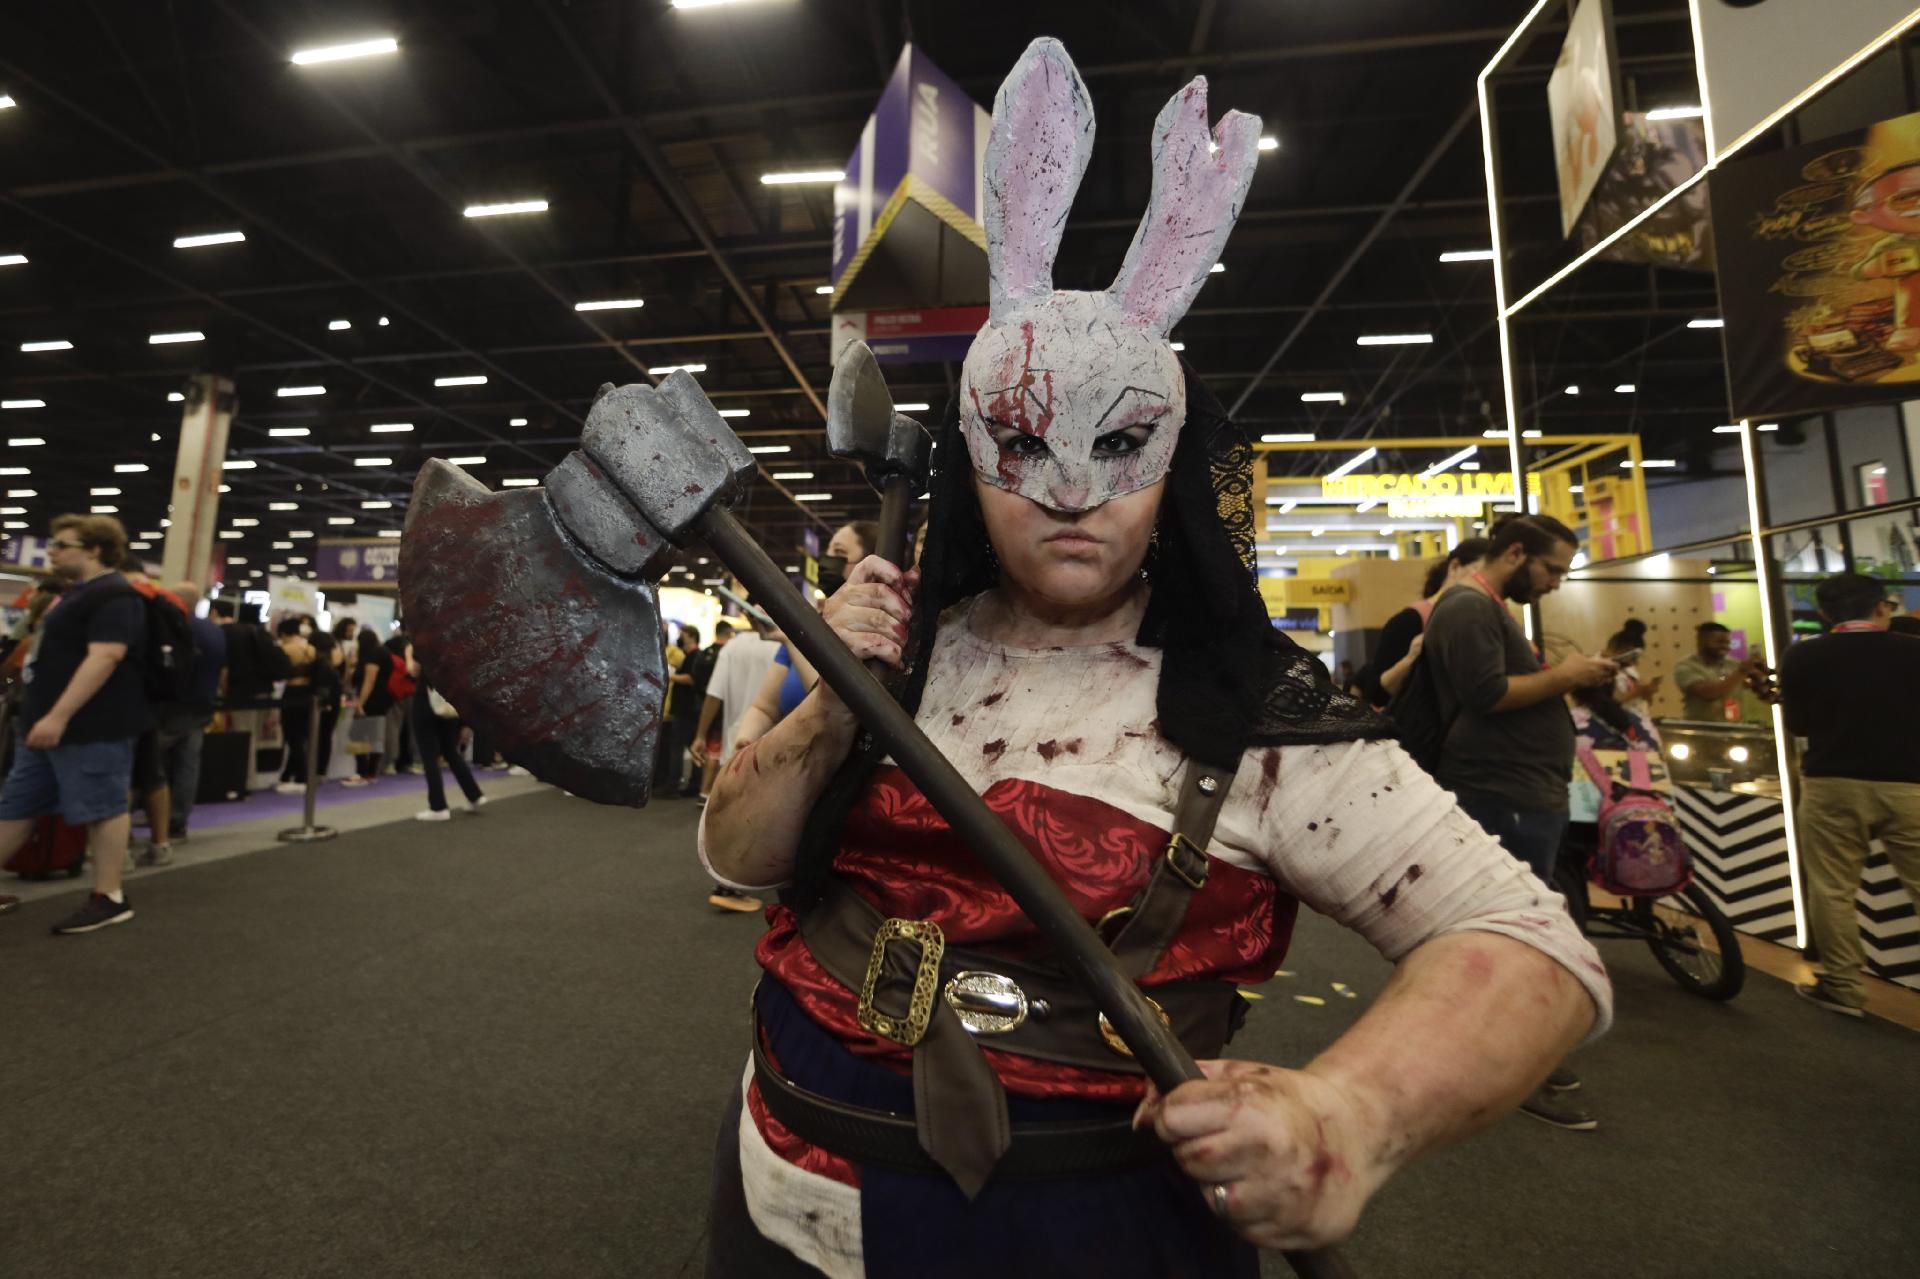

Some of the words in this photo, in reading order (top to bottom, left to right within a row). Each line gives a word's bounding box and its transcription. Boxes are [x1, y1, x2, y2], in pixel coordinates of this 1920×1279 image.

[917, 82, 939, 165] RUA
[1321, 473, 1458, 498] MERCADO
[1461, 471, 1541, 497] LIVE
